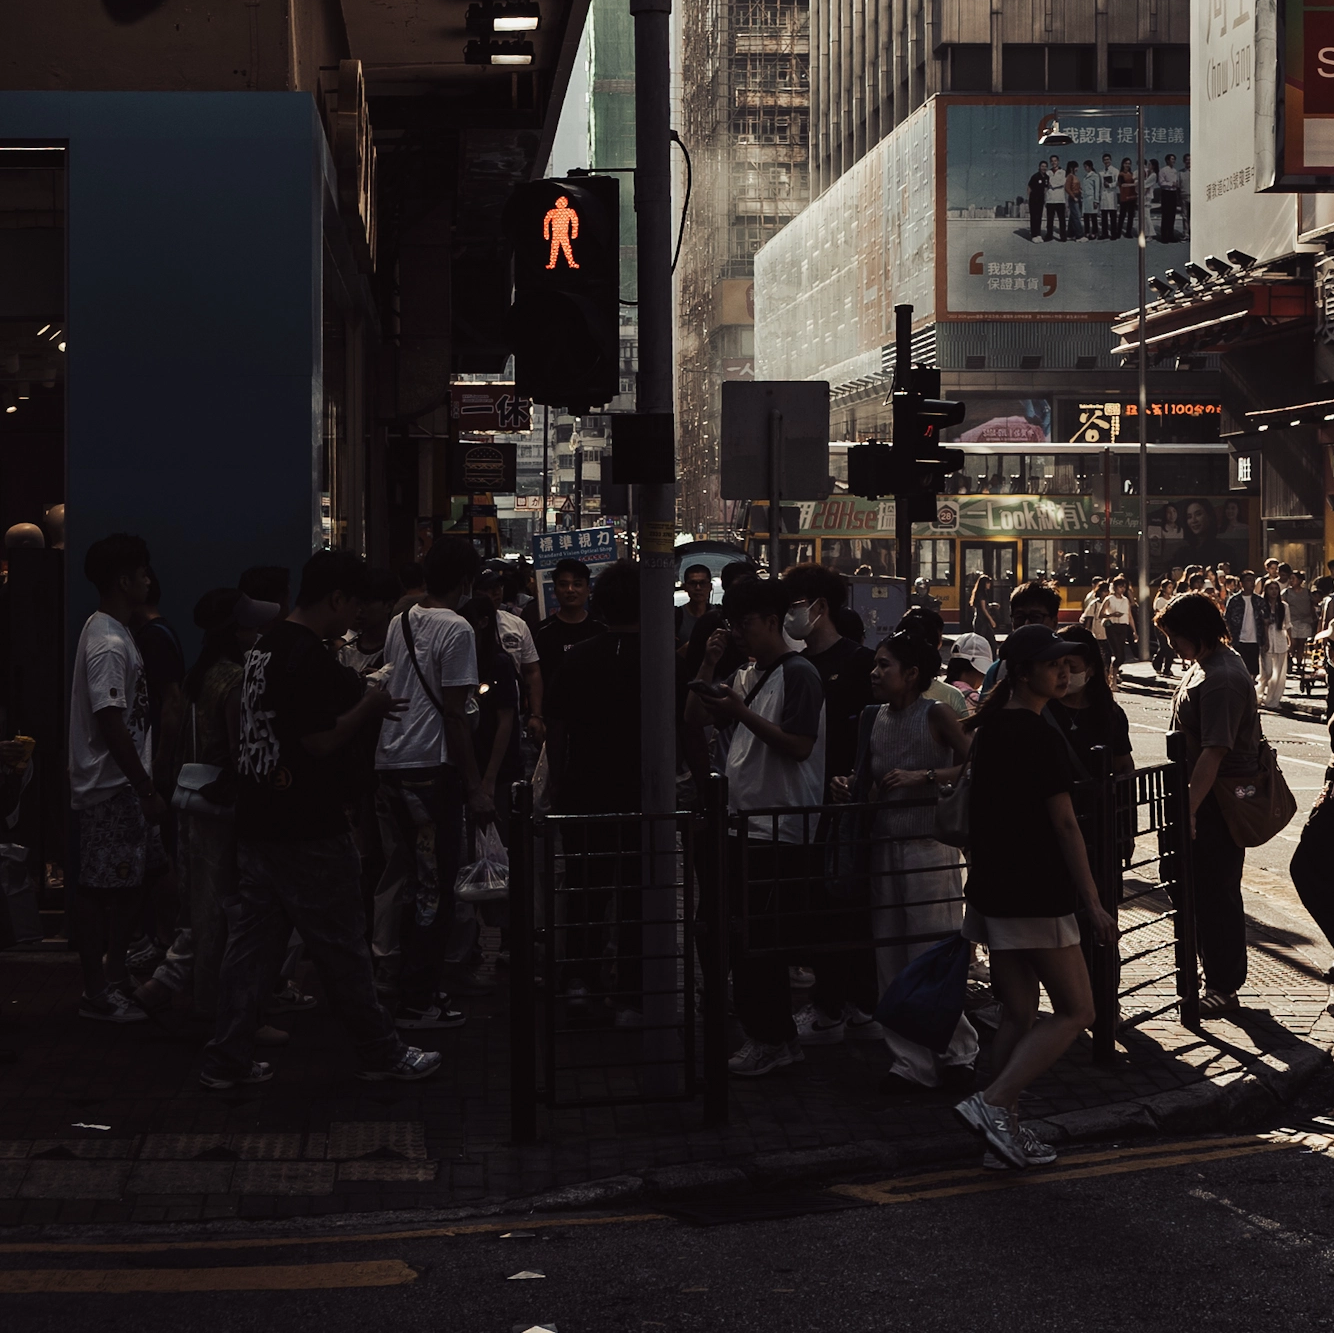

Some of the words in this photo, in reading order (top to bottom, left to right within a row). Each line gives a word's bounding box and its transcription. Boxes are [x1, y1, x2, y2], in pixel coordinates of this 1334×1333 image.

[988, 262, 1026, 275] 我認真
[988, 277, 1039, 291] 保證真貨
[461, 394, 530, 427] 一休
[539, 531, 610, 553] 標準視力
[538, 550, 562, 558] Standard
[563, 549, 580, 557] Vision
[581, 547, 598, 555] Optical
